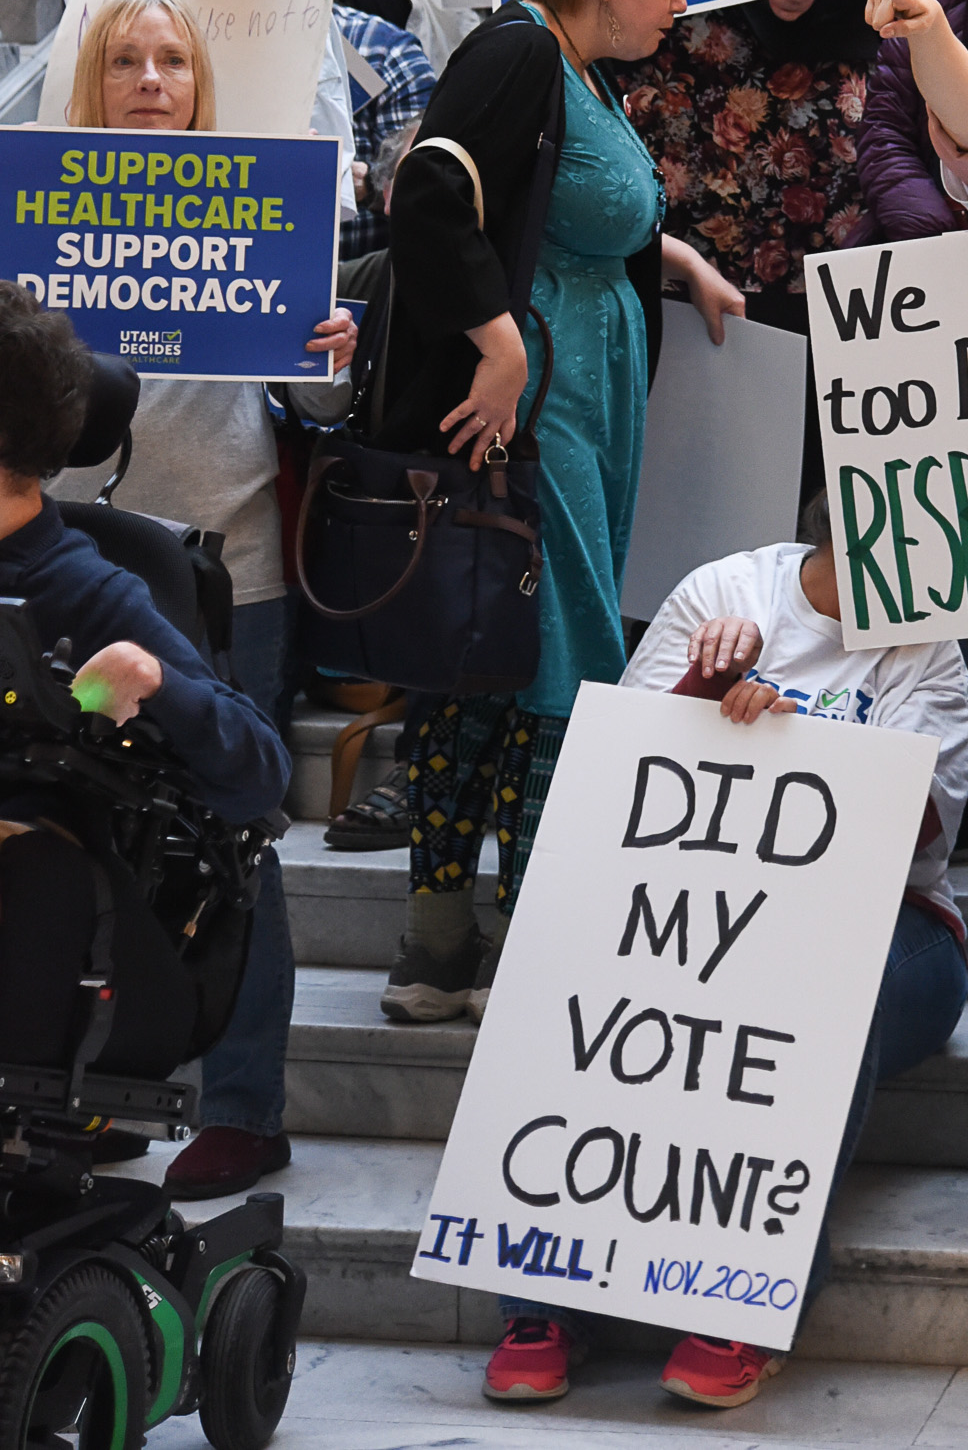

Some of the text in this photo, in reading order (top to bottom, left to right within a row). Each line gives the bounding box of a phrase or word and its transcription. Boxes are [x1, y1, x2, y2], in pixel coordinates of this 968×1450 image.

[248, 0, 319, 37] not to
[60, 150, 256, 189] SUPPORT
[16, 190, 295, 231] HEALTHCARE.
[55, 232, 253, 272] SUPPORT
[17, 273, 286, 314] DEMOCRACY.
[816, 250, 940, 342] We
[120, 330, 159, 342] UTAH
[120, 343, 181, 355] DECIDES
[823, 377, 937, 436] too
[621, 754, 838, 867] DID
[616, 882, 769, 983] MY
[567, 993, 795, 1107] VOTE
[502, 1114, 811, 1236] COUNT?
